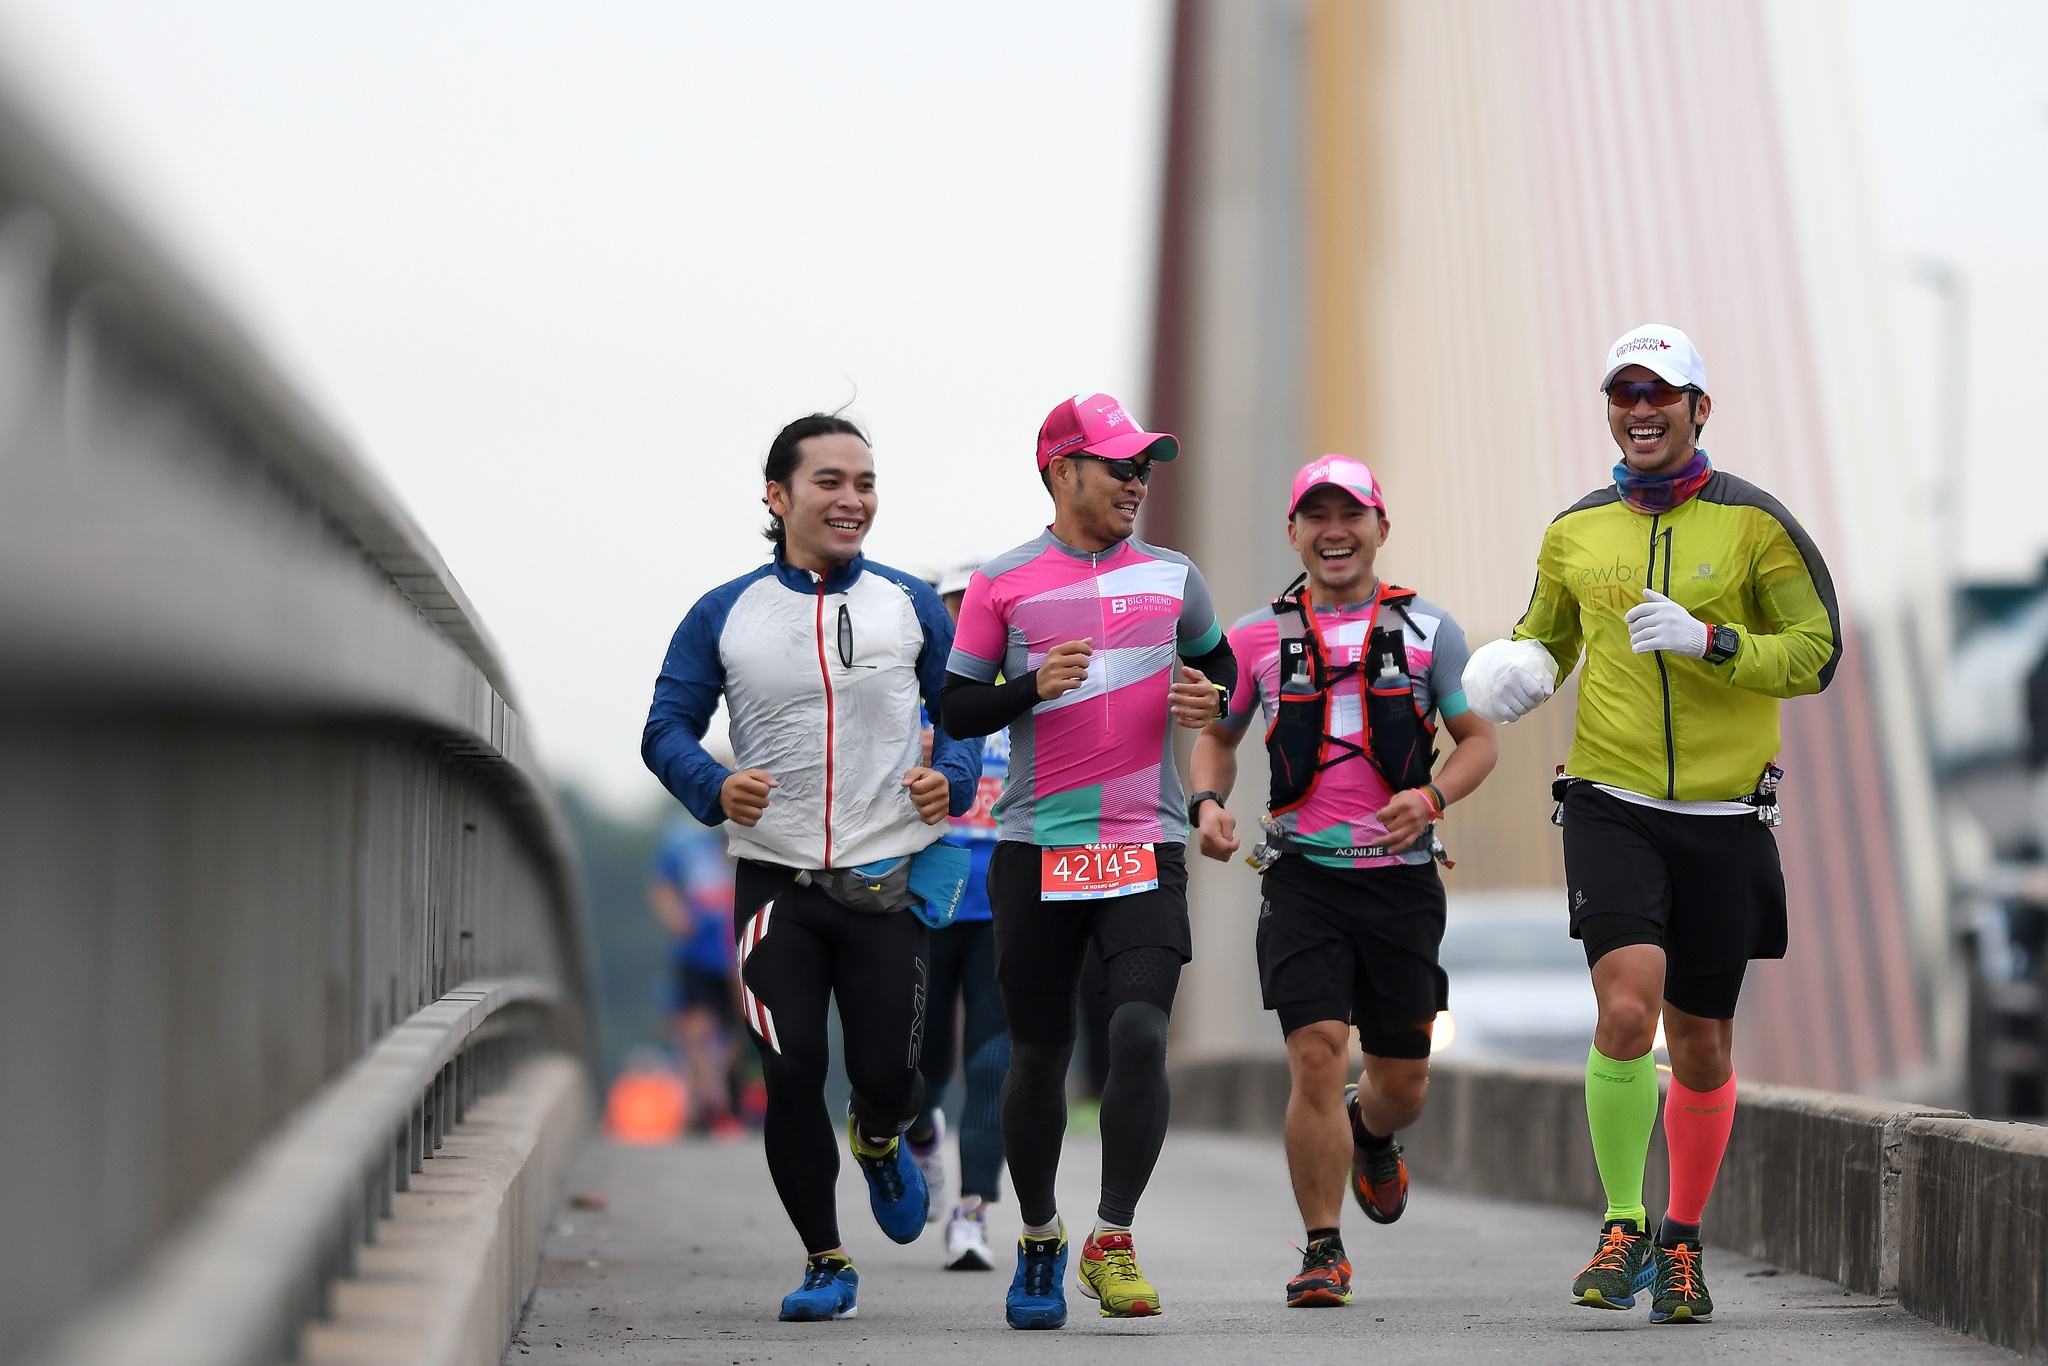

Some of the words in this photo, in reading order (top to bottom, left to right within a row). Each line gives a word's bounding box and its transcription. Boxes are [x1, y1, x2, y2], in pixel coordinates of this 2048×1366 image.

[1128, 596, 1143, 605] BIG
[1144, 595, 1172, 606] FRIEND
[1335, 846, 1384, 857] AONIJIE
[1053, 850, 1142, 882] 42145
